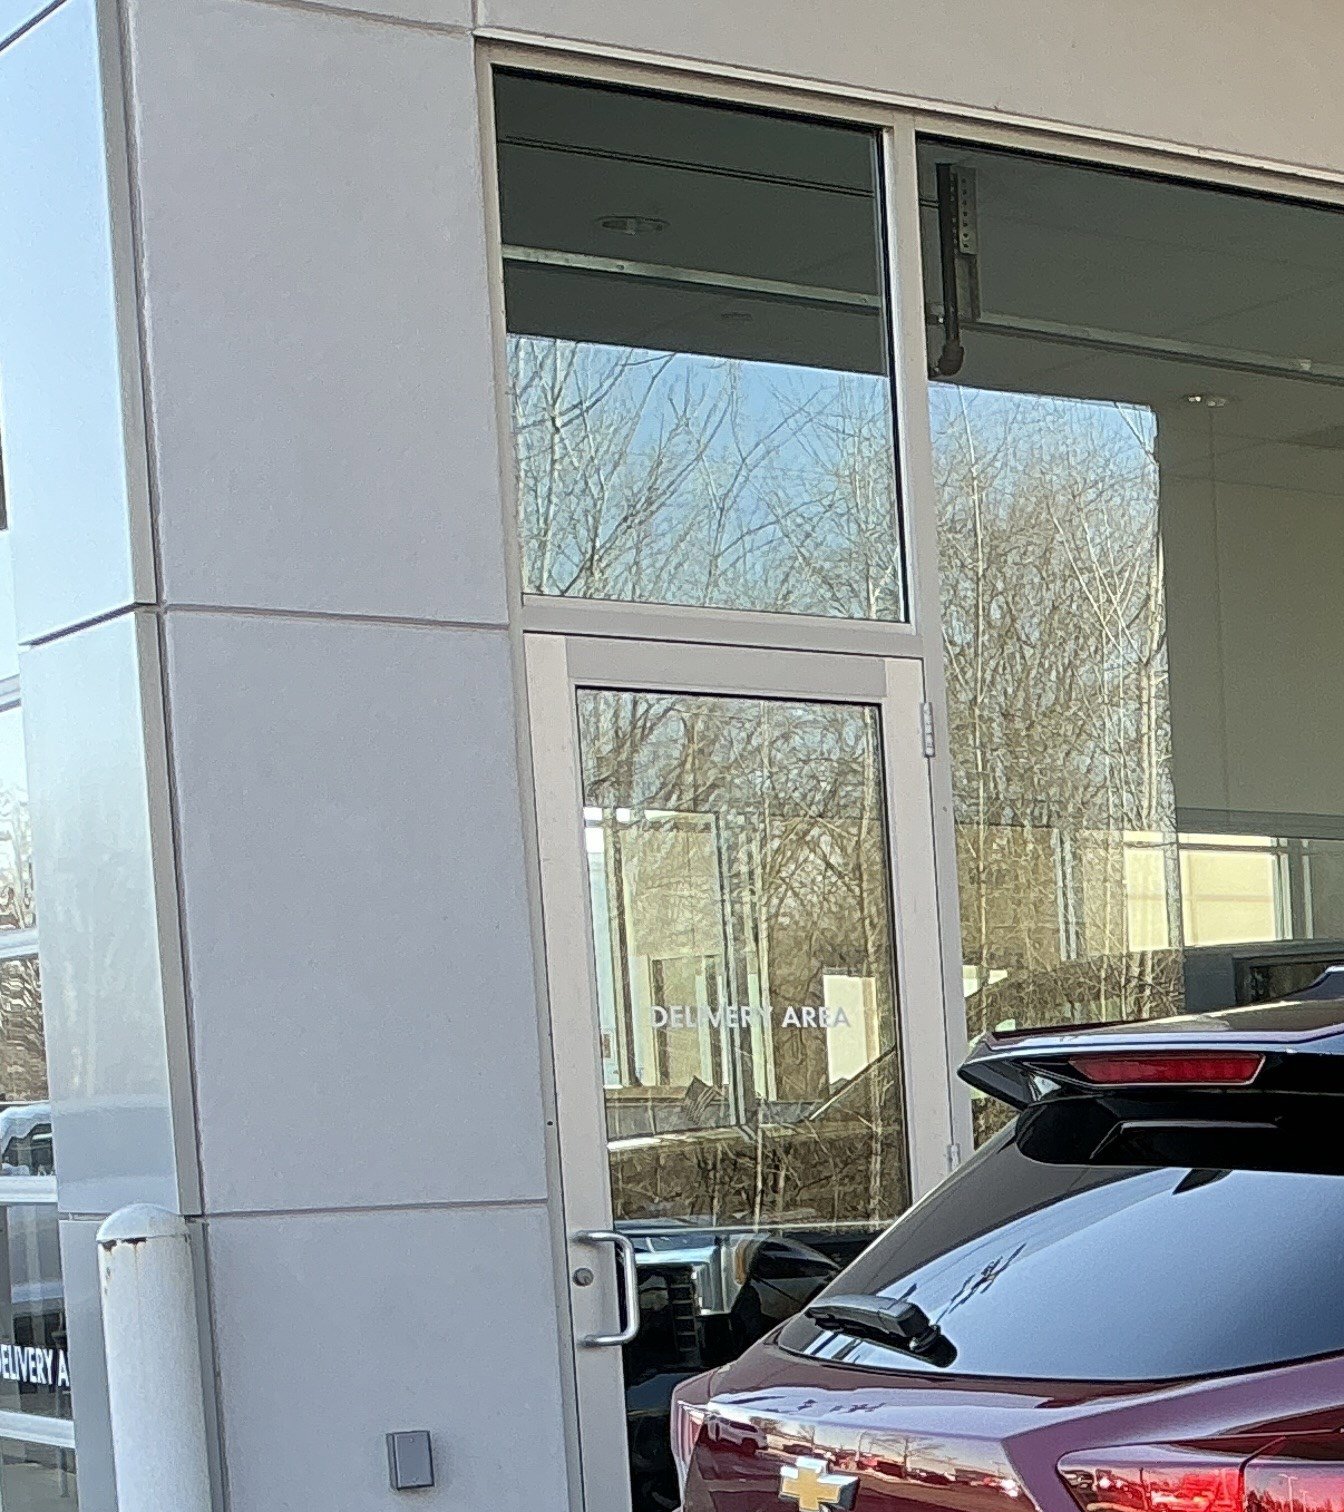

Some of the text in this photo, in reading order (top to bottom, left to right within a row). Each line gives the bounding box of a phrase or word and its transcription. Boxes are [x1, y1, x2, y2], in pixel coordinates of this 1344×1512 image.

[650, 1005, 850, 1028] DELIVERY AREA
[0, 1344, 53, 1385] ELIVERY
